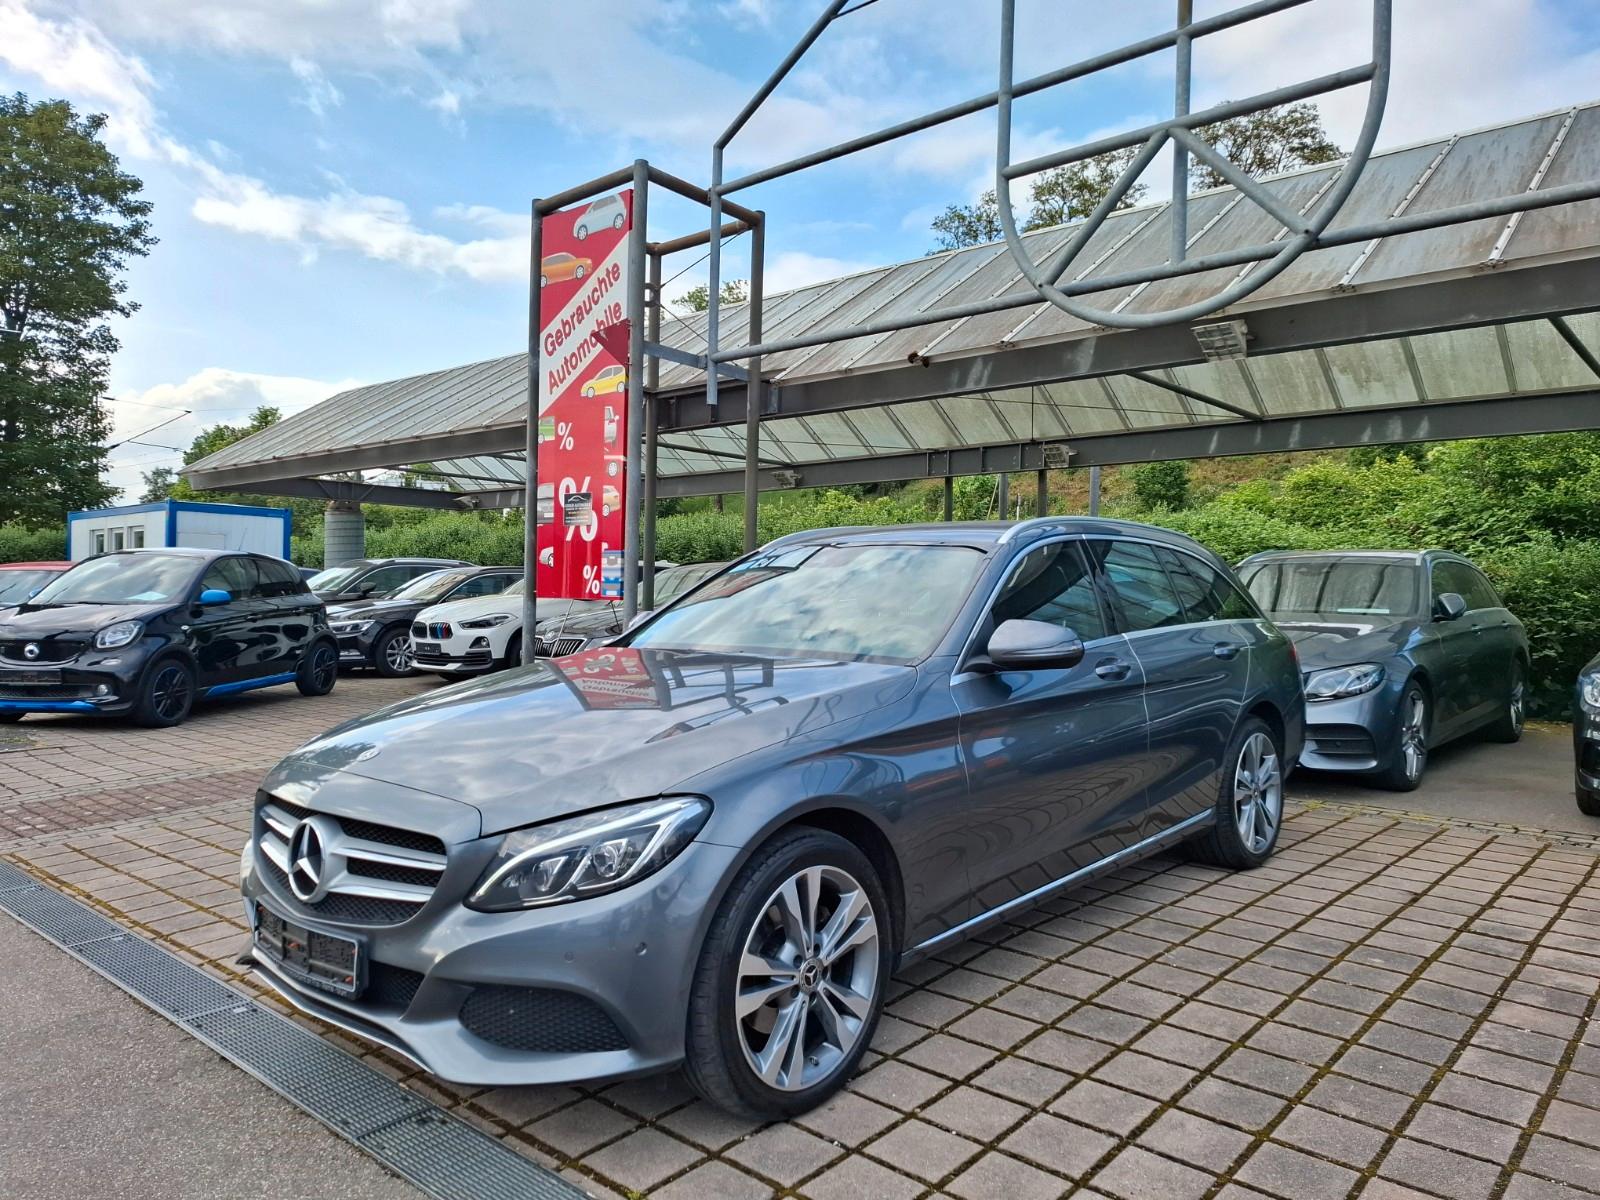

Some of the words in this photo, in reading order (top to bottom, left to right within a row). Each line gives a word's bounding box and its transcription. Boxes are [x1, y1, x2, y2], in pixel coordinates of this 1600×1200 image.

[544, 262, 621, 357] Gebrauchte
[557, 422, 574, 450] %
[558, 476, 598, 542] %
[583, 565, 600, 595] %
